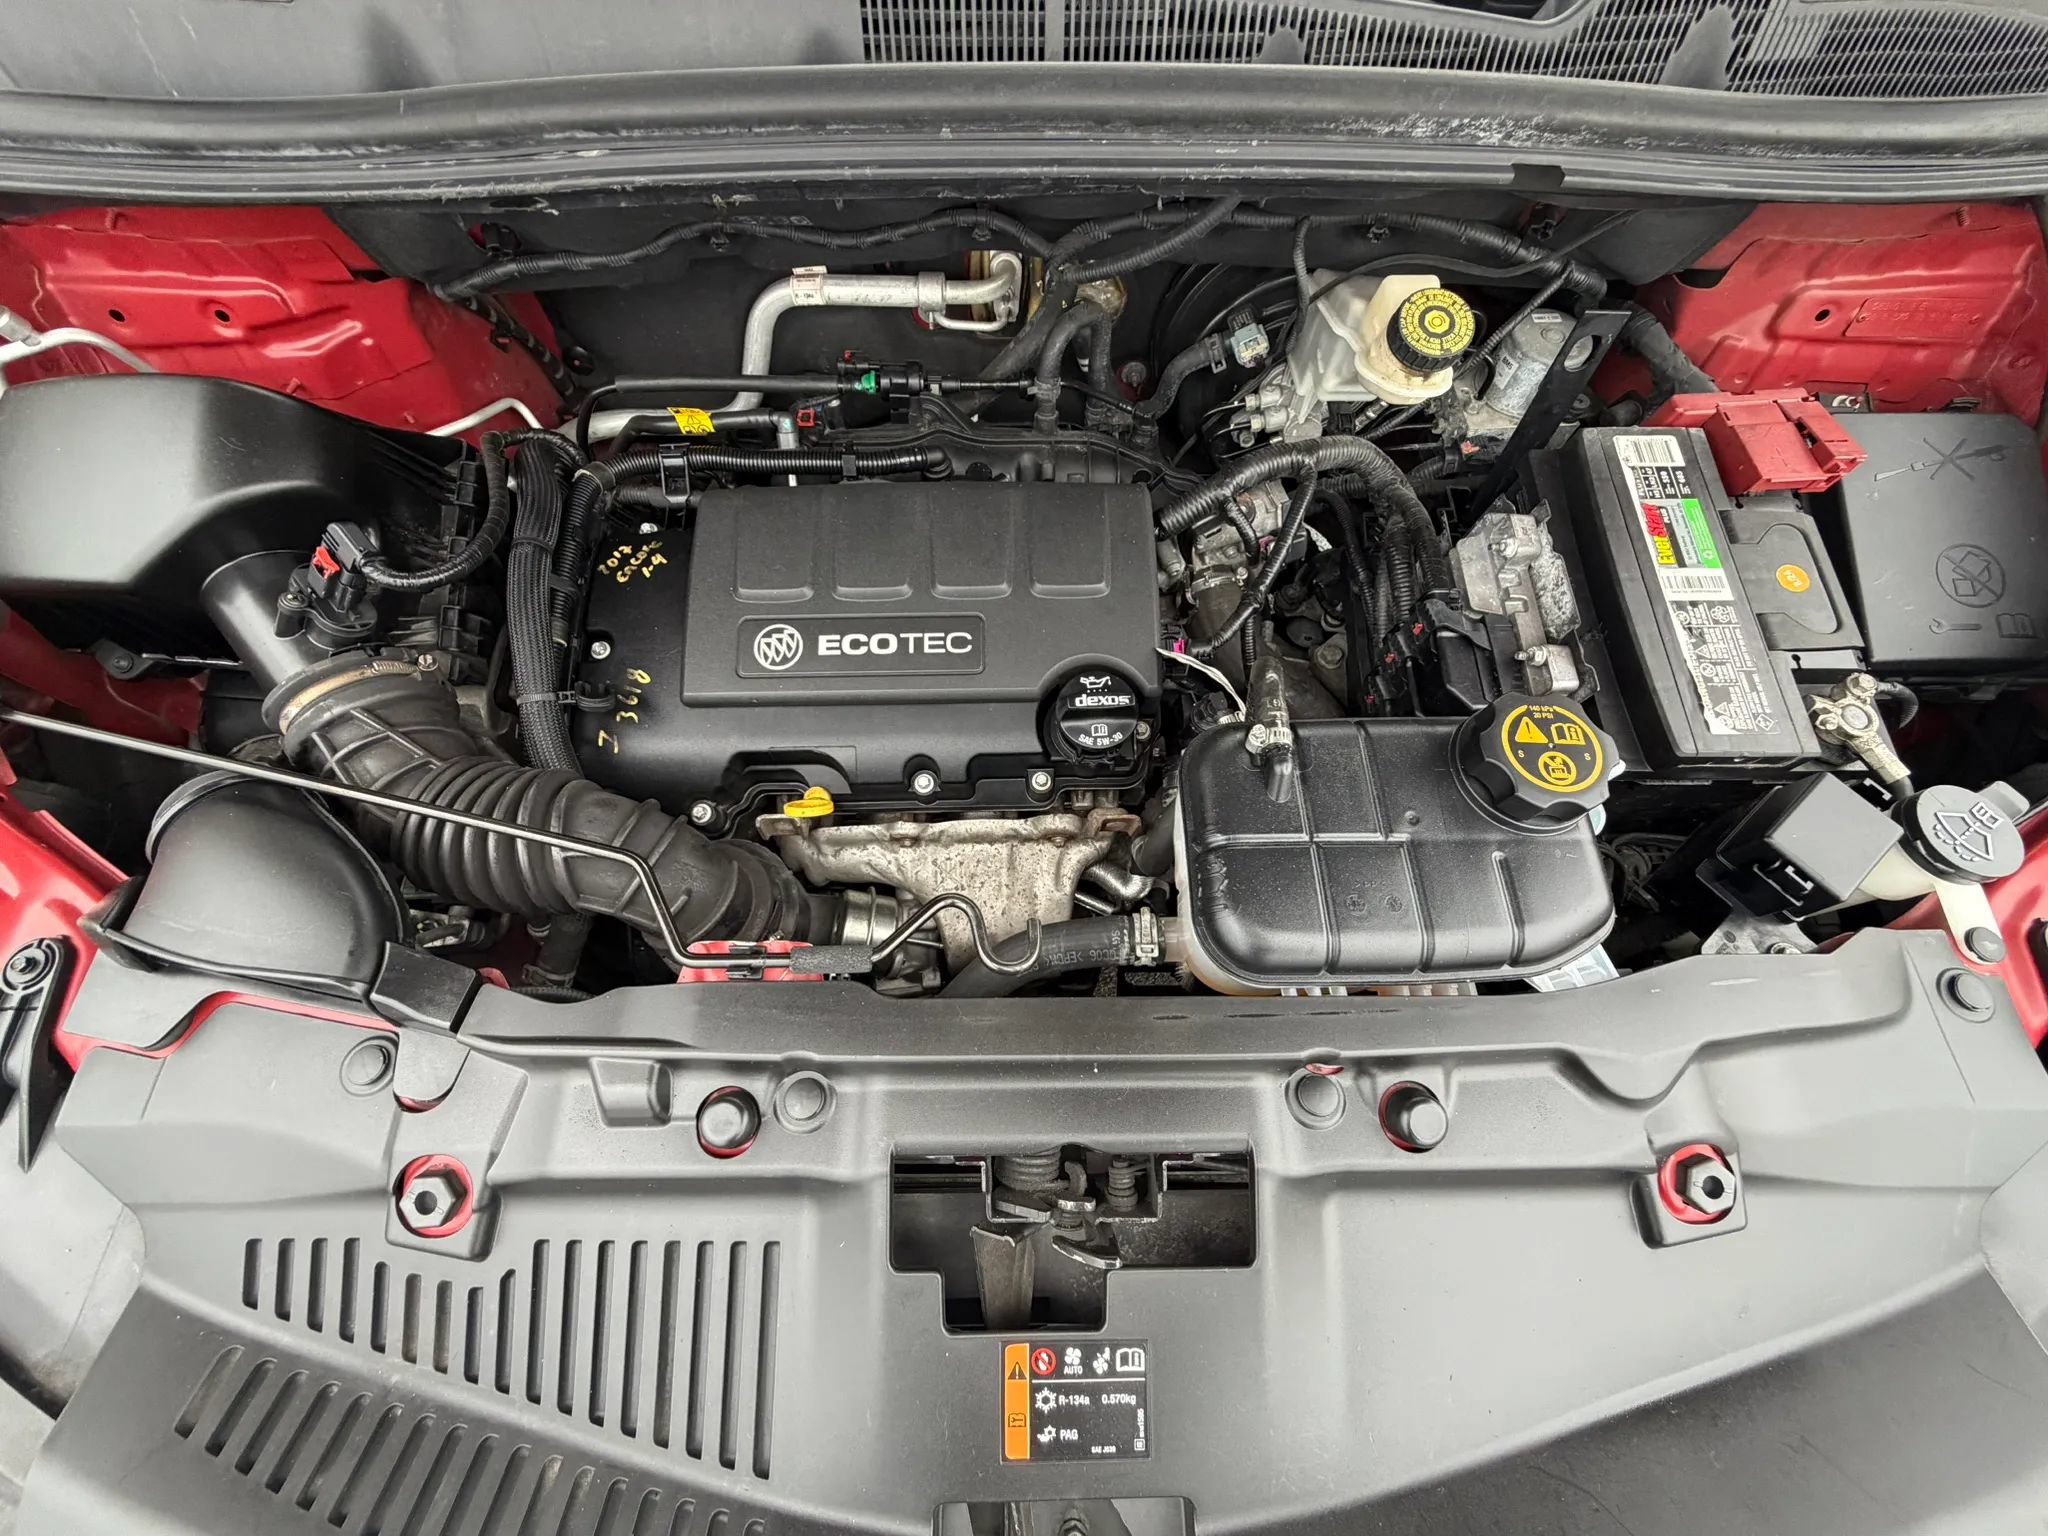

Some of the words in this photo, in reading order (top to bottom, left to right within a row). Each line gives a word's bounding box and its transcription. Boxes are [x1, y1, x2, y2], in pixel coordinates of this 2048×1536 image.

[817, 632, 973, 656] ECOTEC
[1075, 693, 1131, 707] dexos
[1078, 733, 1094, 746] SAE
[1096, 731, 1123, 746] 5W-30
[1063, 1365, 1083, 1375] AUTO
[1058, 1394, 1090, 1405] R-134a
[1101, 1393, 1137, 1405] 0.570kg
[1059, 1428, 1079, 1441] PAG
